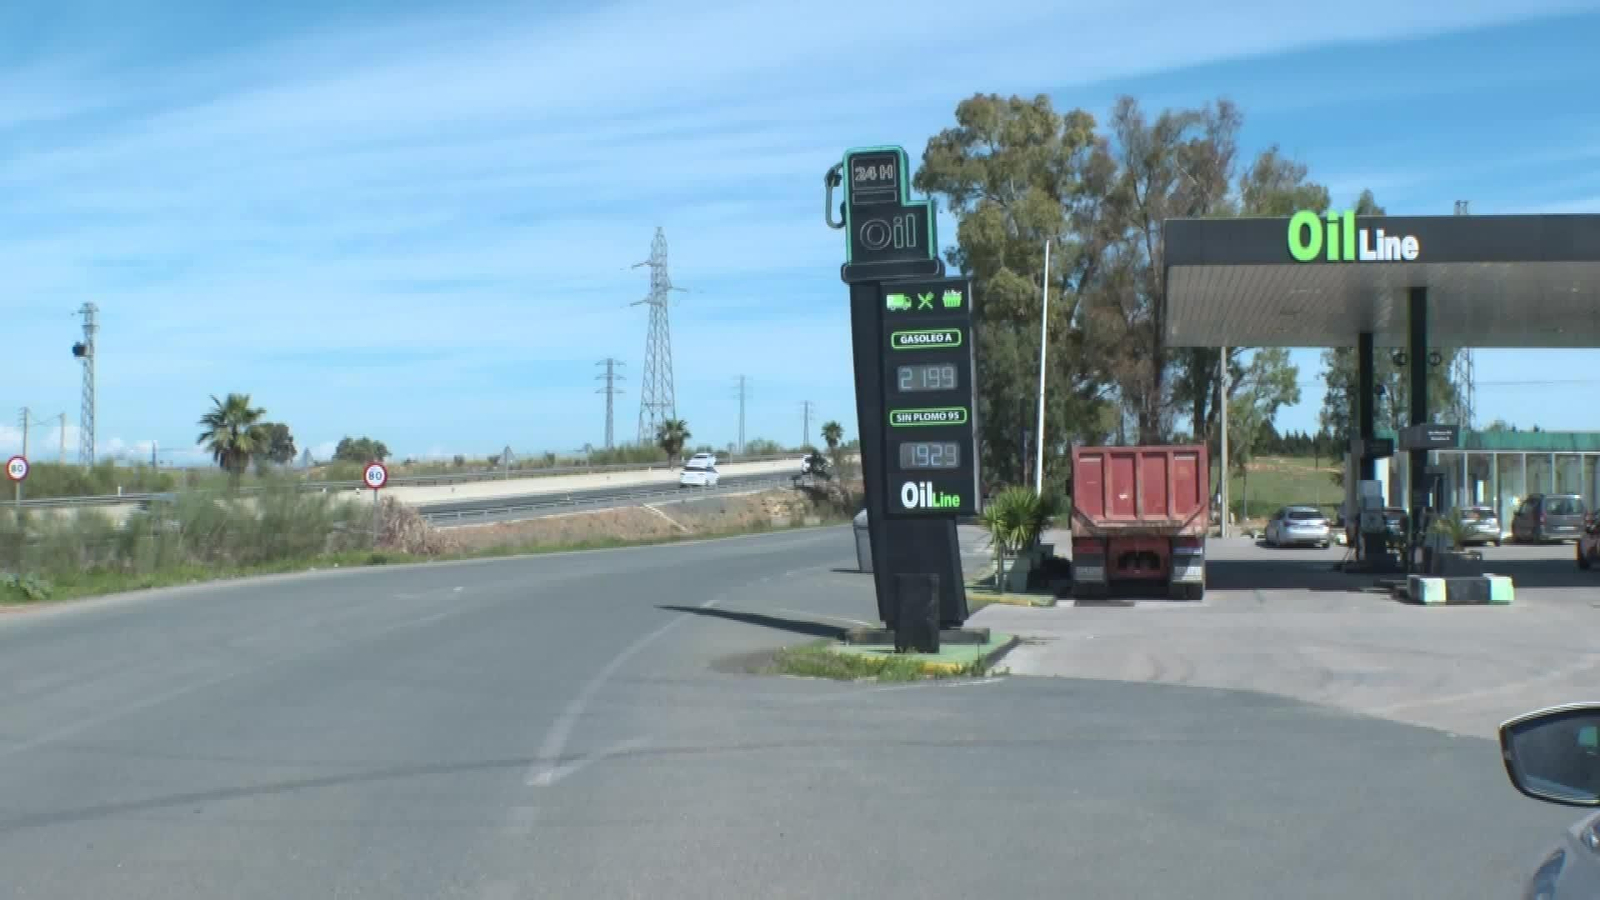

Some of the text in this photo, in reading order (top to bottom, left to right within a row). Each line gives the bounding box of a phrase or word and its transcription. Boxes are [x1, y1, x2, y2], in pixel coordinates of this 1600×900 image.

[855, 164, 893, 181] 24 H
[1288, 209, 1419, 261] Oil Line
[900, 333, 953, 344] GASOLEO A
[896, 411, 960, 422] SIN PLOMO 95
[911, 444, 957, 466] 1929
[368, 471, 383, 481] 80
[901, 481, 960, 509] Oil Line
